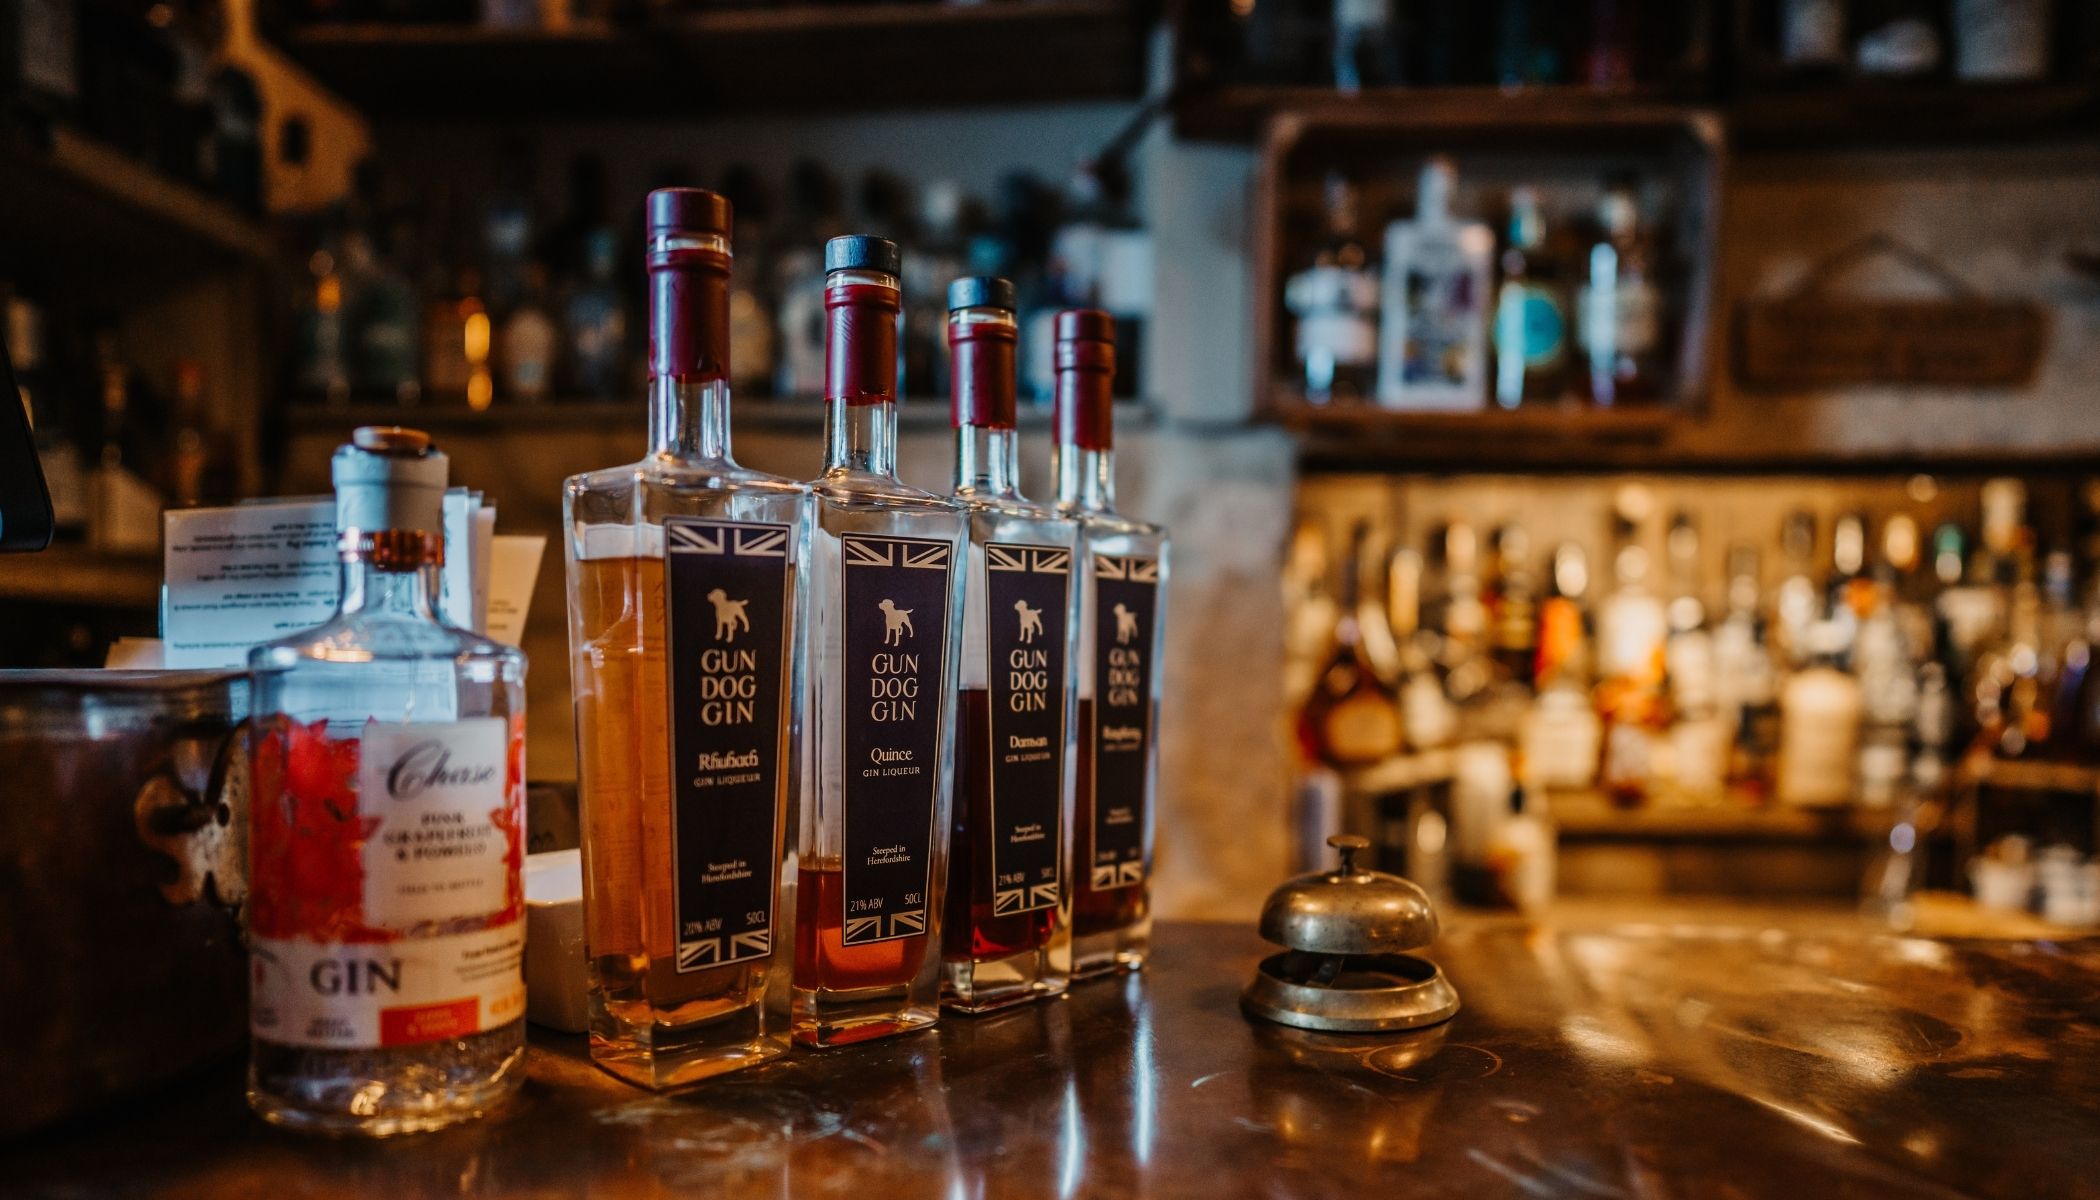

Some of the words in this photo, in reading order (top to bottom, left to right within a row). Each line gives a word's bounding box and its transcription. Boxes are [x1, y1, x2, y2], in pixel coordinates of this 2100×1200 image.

[701, 649, 756, 674] GUN
[872, 653, 919, 674] GUN
[1010, 649, 1047, 669] GUN
[1108, 648, 1139, 667] GUN
[701, 675, 757, 700] DOG
[870, 677, 919, 698] DOG
[1010, 671, 1048, 691] DOG
[1109, 669, 1140, 687] DOG
[1010, 692, 1046, 712] GIN
[1108, 688, 1138, 706] GIN
[701, 701, 755, 726] GIN
[871, 701, 917, 721] GIN
[1010, 735, 1048, 749] Damson
[870, 747, 913, 765] Quince
[693, 776, 713, 788] GIN
[717, 773, 761, 786] LIQUEUR
[863, 769, 879, 777] GIN
[882, 767, 920, 777] LIQUEUR
[867, 855, 911, 866] Herefordshire
[873, 844, 898, 857] Steeped
[899, 845, 906, 853] in
[850, 900, 867, 912] 21%
[868, 897, 884, 909] ABV
[905, 892, 922, 904] 50CL
[746, 910, 766, 925] 50CL
[309, 958, 404, 996] GIN
